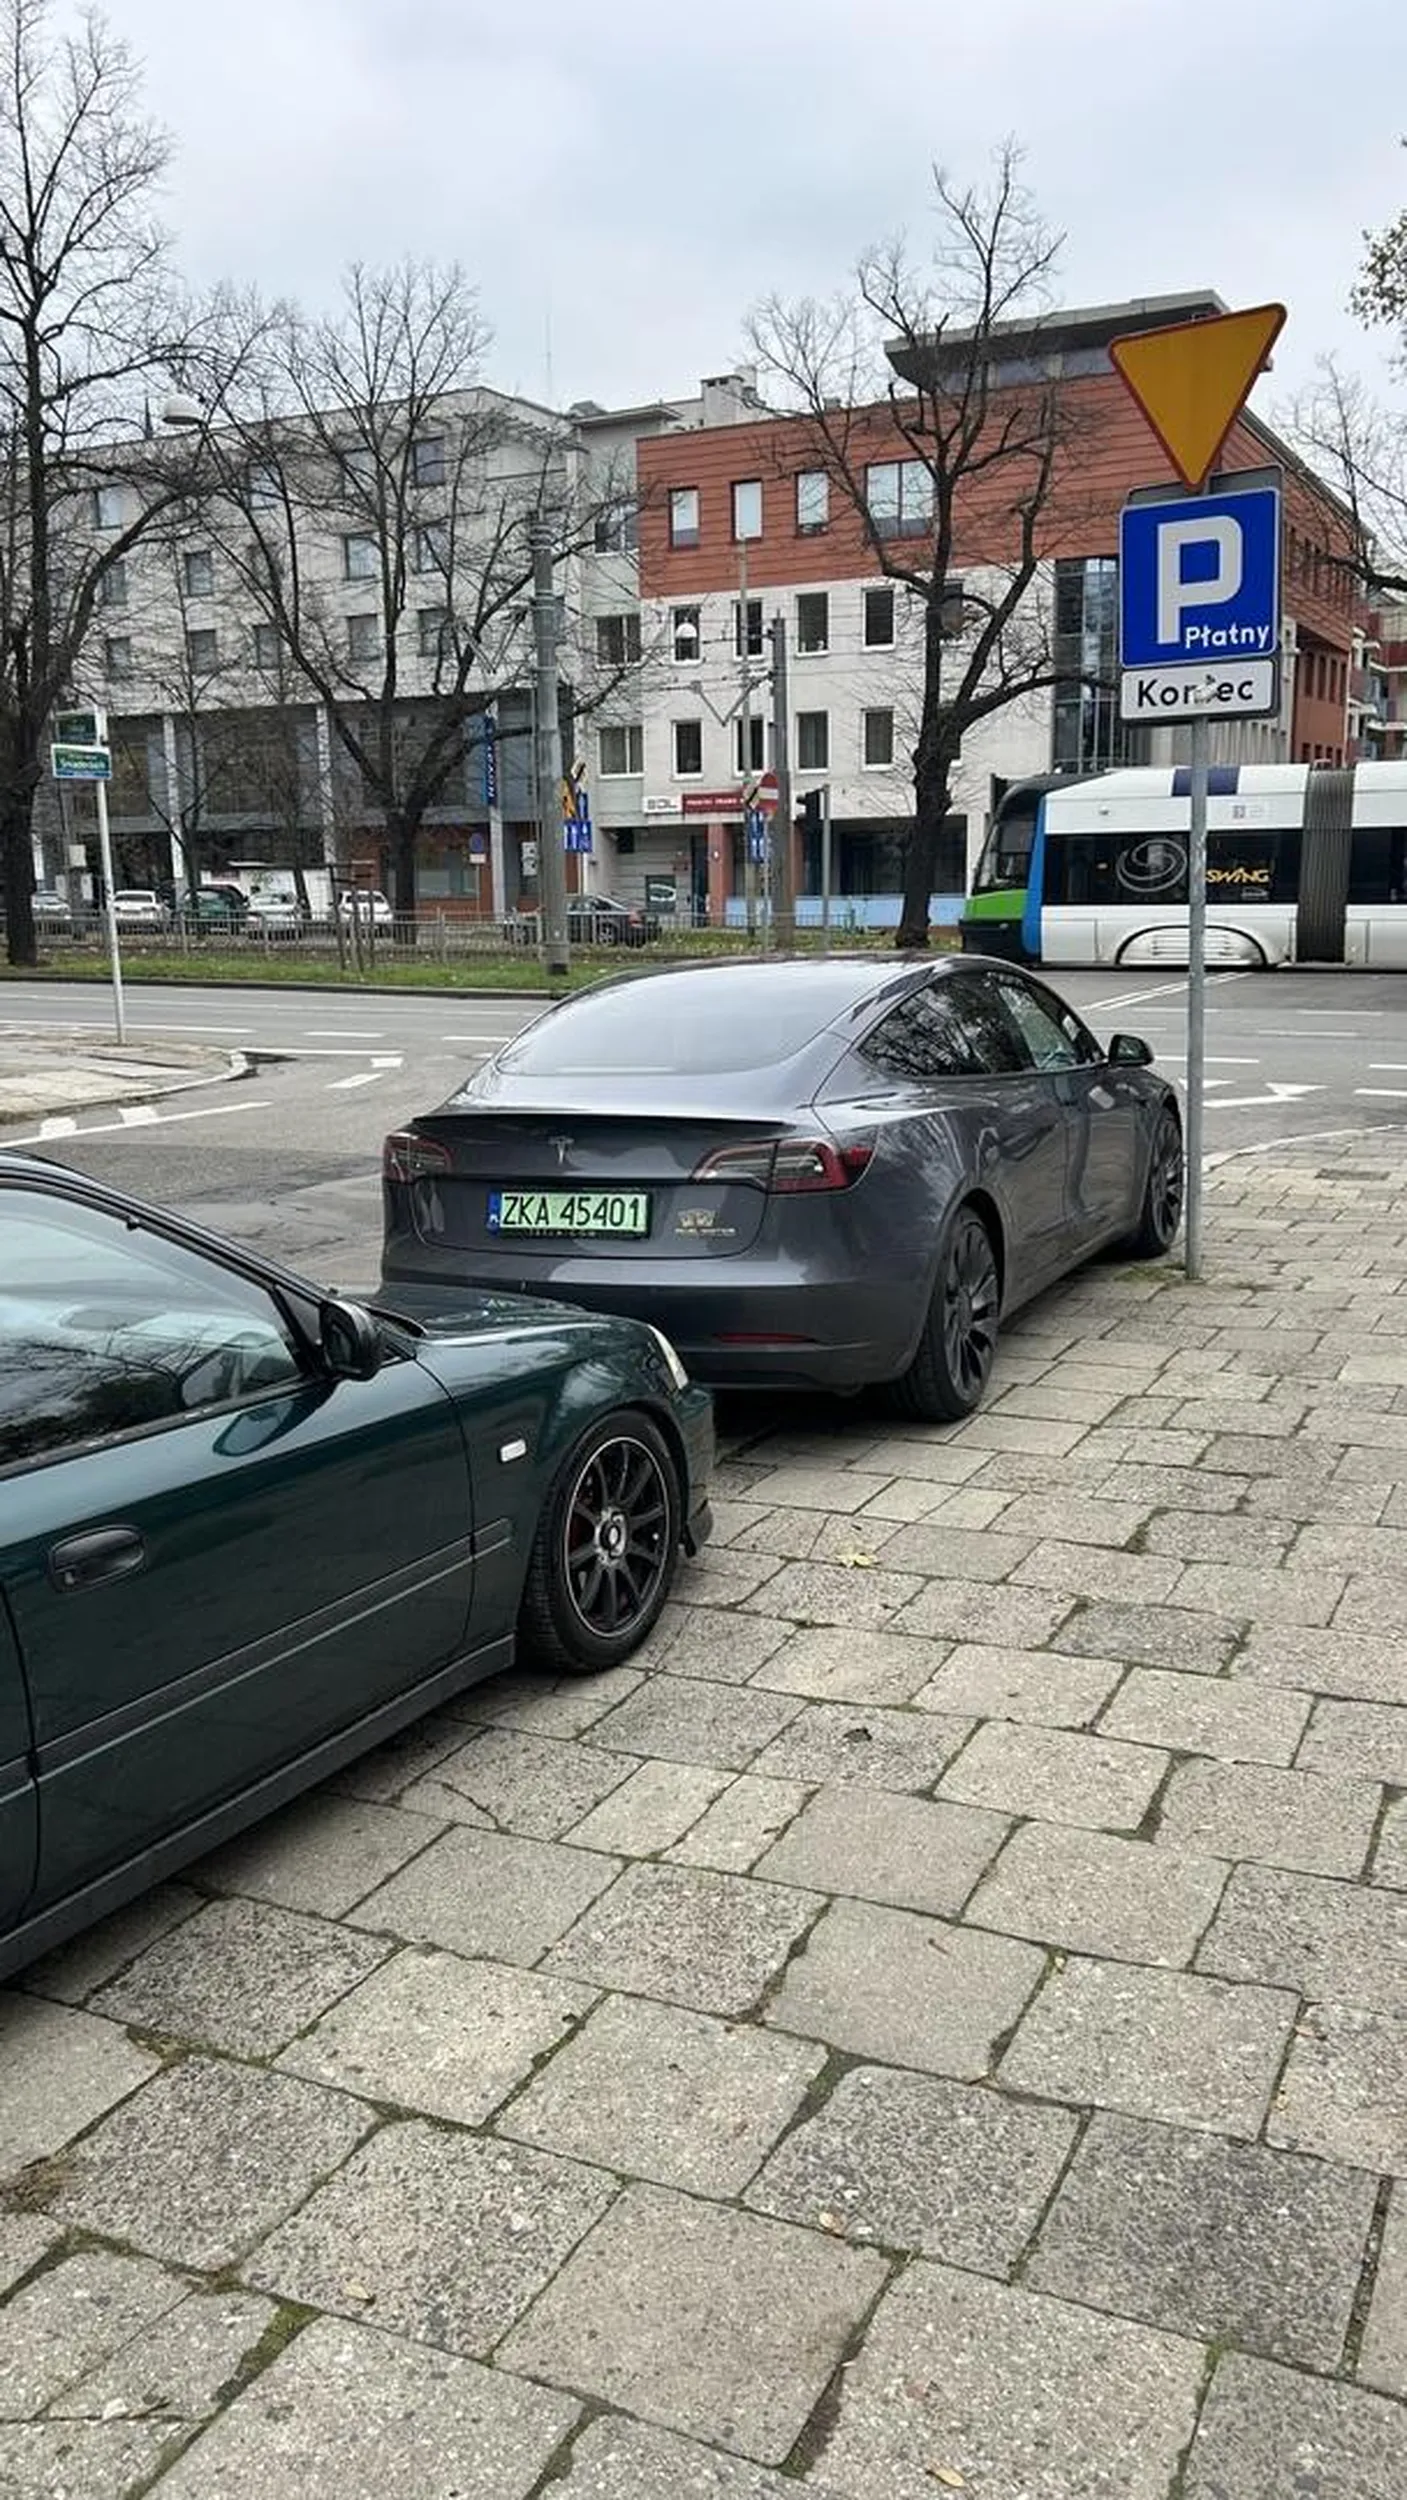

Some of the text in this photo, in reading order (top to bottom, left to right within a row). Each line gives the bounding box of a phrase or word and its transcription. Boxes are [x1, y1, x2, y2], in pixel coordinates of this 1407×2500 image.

[1157, 515, 1244, 645] P
[1185, 622, 1270, 649] Płatny
[1206, 867, 1269, 883] SWING
[503, 1196, 640, 1228] ZKA 45401
